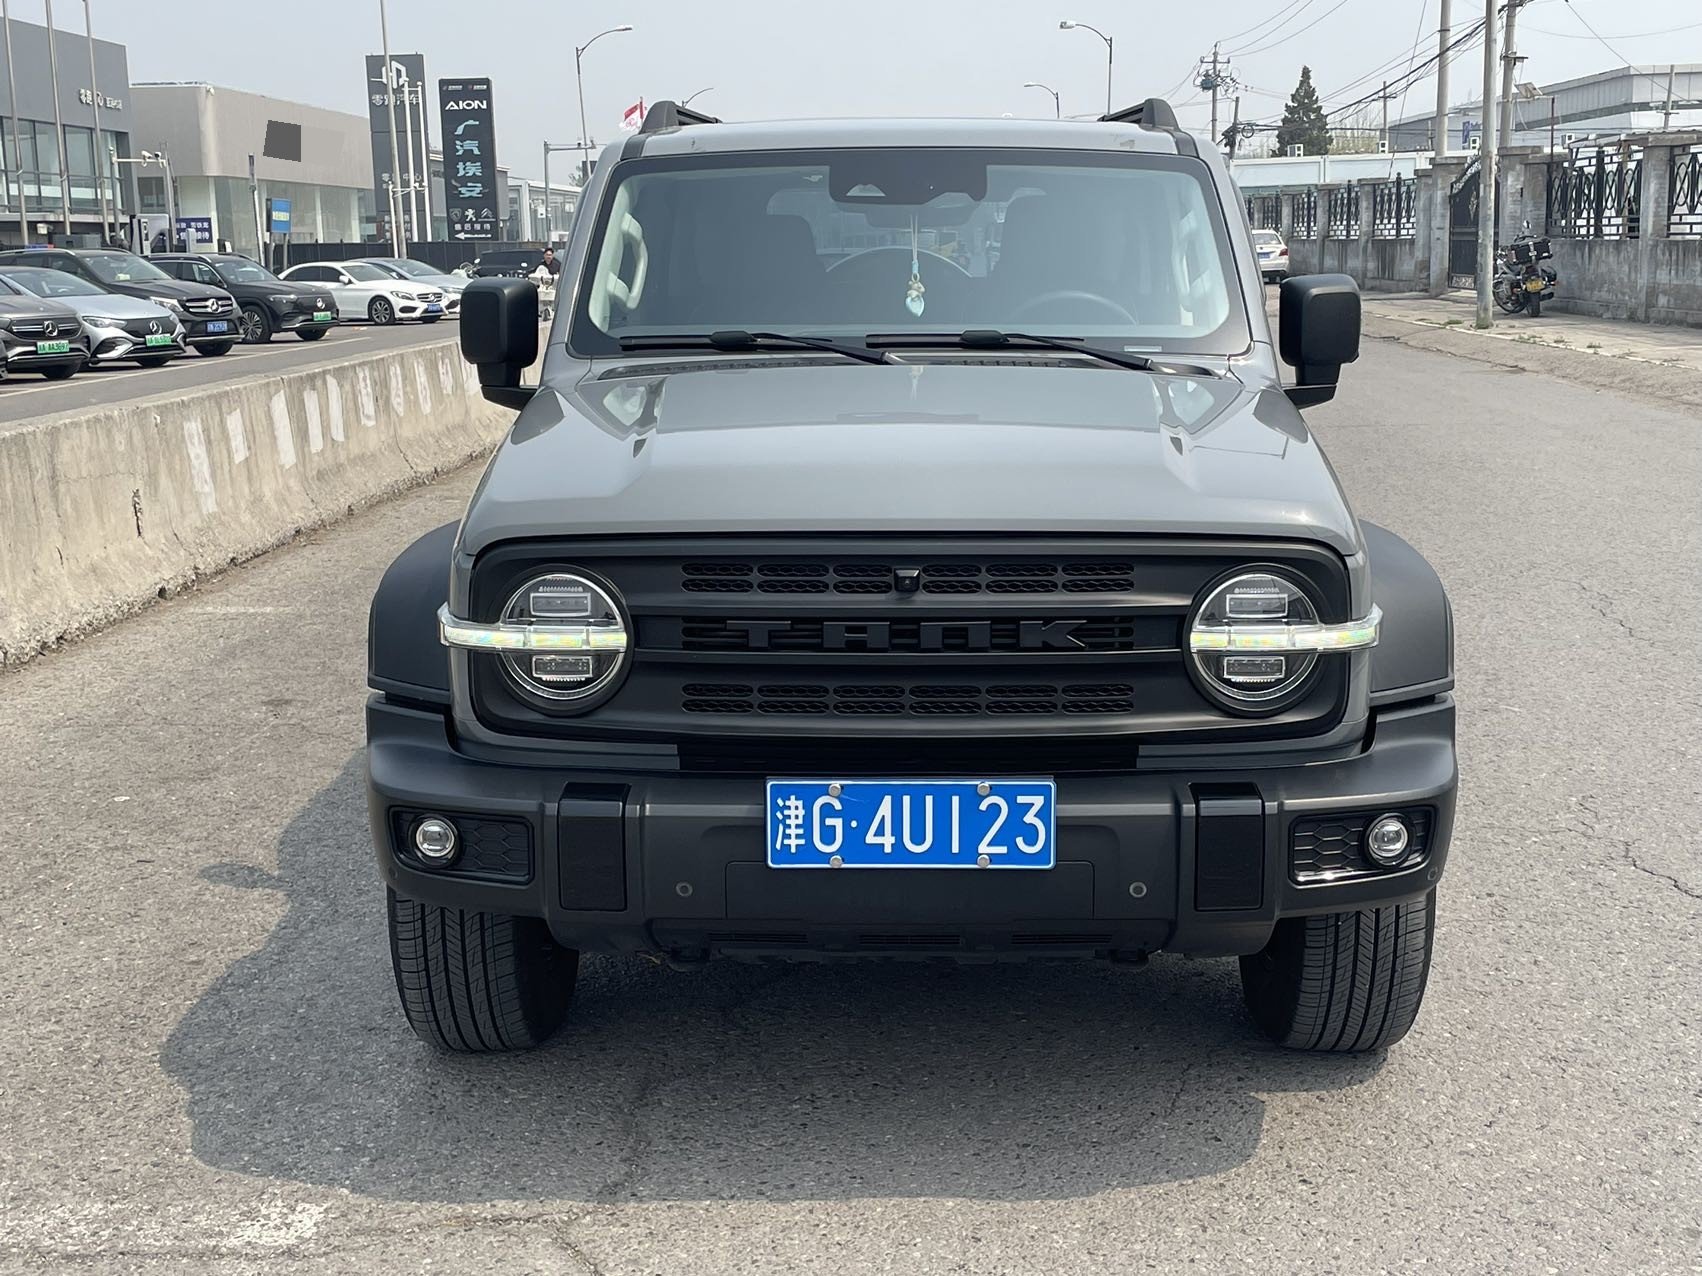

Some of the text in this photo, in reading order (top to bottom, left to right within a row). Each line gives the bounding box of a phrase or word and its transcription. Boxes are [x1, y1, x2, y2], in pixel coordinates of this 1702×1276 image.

[445, 100, 487, 110] AION
[454, 119, 483, 198] 广汽埃安
